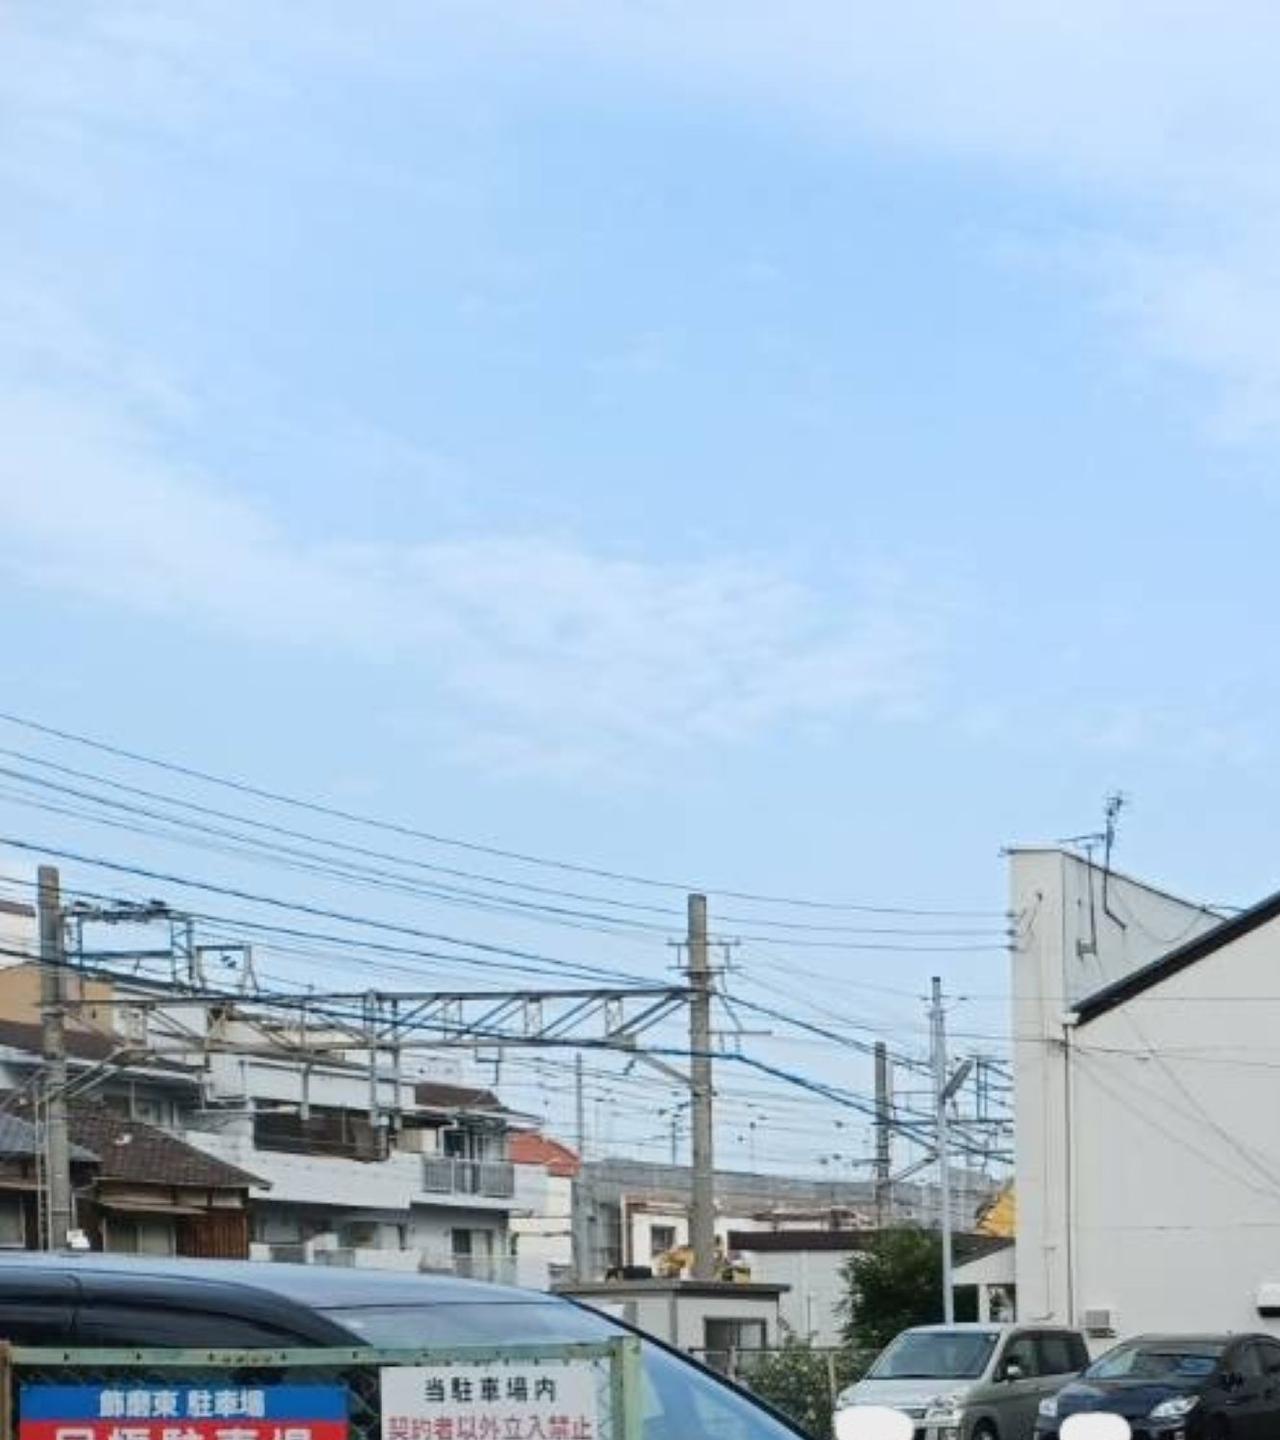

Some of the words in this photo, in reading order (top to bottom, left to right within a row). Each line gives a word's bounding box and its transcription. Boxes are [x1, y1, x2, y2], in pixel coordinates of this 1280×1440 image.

[187, 1389, 266, 1417] 駐車場
[424, 1376, 557, 1403] 当駐車場内
